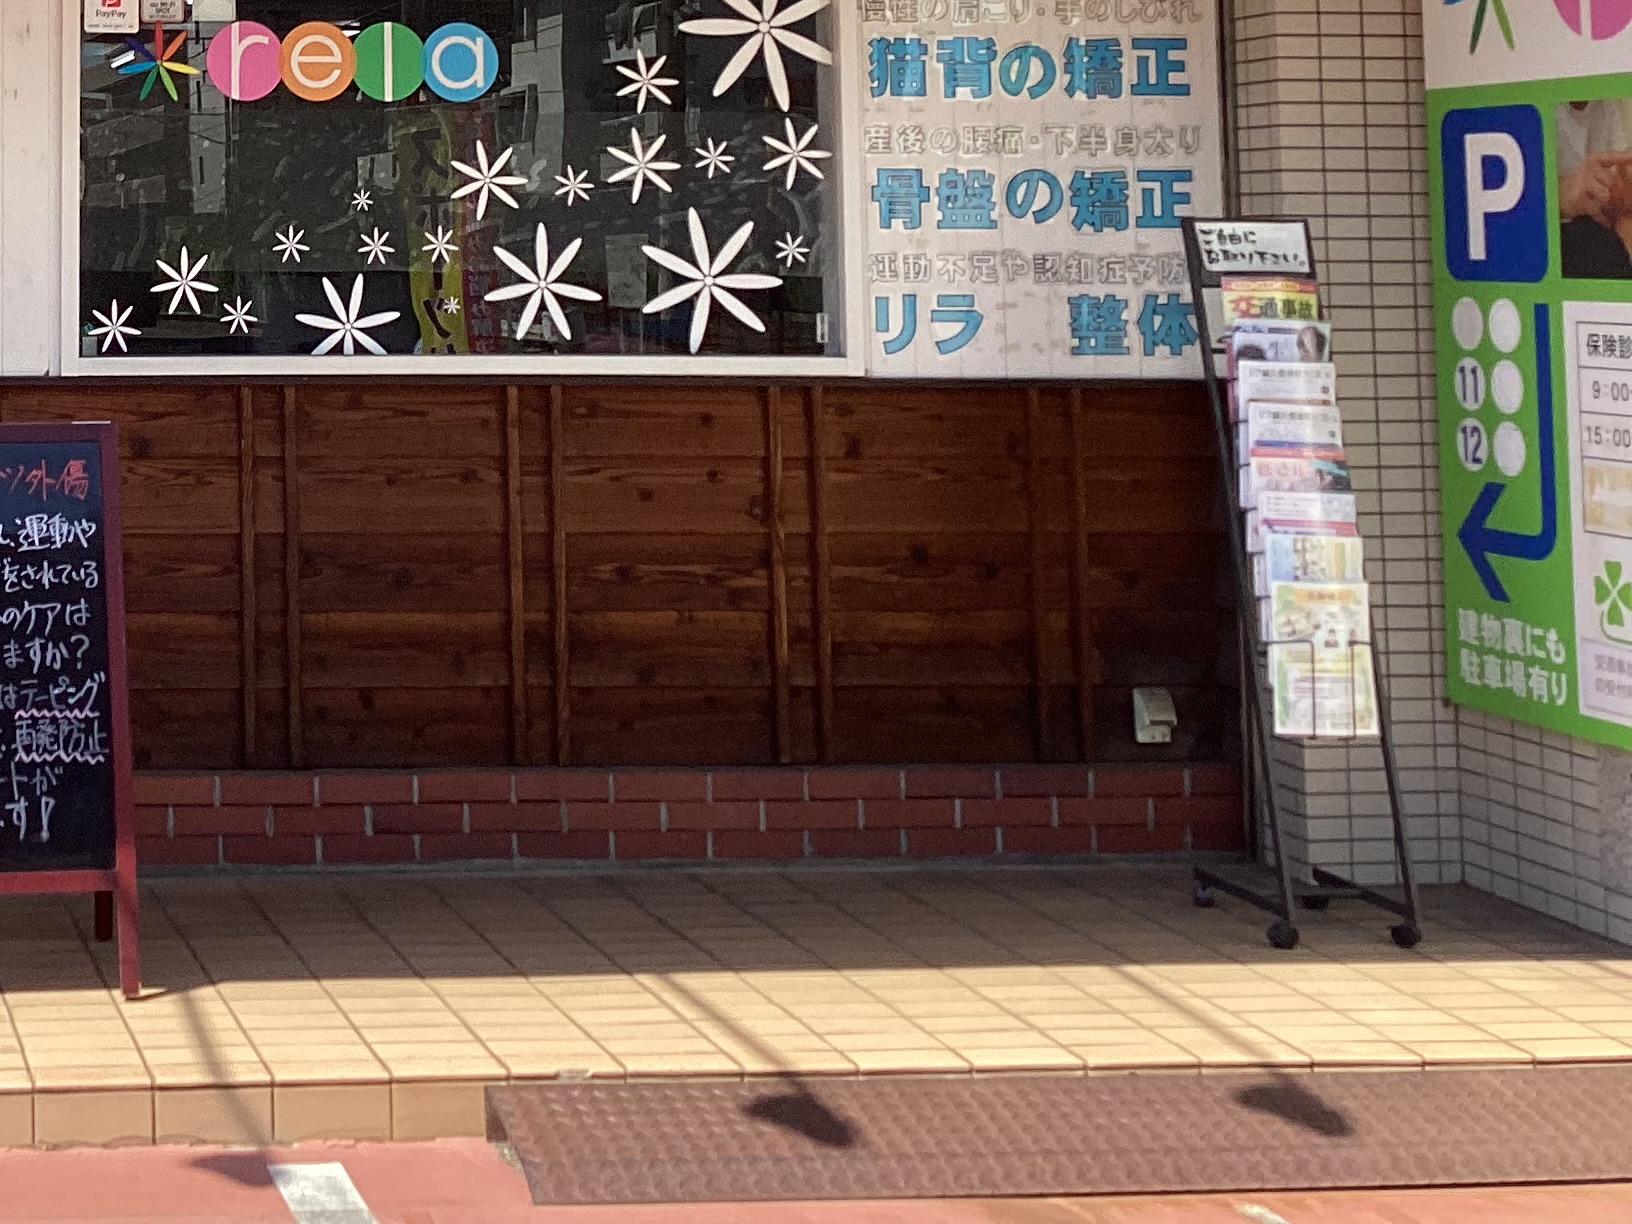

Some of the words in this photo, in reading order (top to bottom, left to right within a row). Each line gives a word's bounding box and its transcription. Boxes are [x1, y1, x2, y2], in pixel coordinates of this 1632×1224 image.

[95, 9, 127, 19] PayPay
[231, 22, 485, 102] rela
[868, 36, 1191, 99] 猫背の矯正
[871, 167, 1193, 232] 骨盤の矯正
[1463, 131, 1526, 261] P
[874, 293, 985, 356] リラ
[1068, 293, 1199, 356] 整体
[1458, 364, 1480, 405] 11
[1461, 424, 1483, 465] 12
